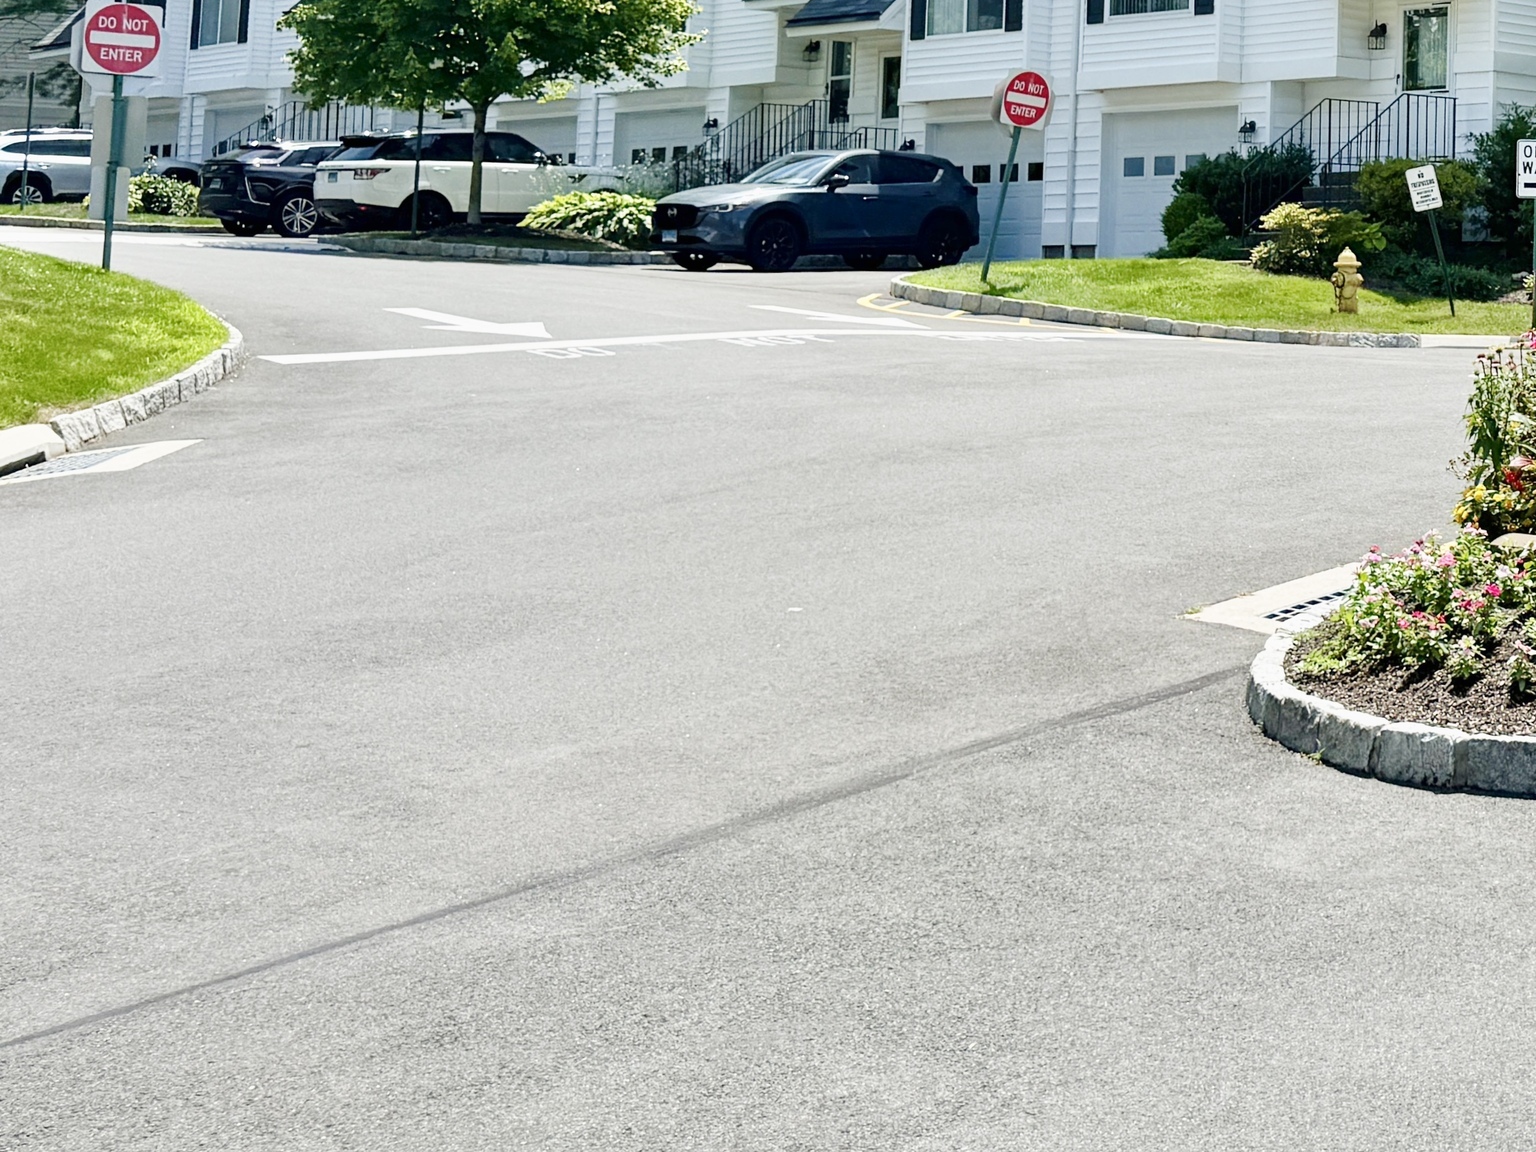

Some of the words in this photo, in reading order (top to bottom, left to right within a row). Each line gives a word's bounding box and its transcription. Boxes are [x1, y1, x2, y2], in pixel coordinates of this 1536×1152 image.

[98, 16, 117, 29] DO
[122, 18, 149, 32] NOT
[100, 47, 142, 63] ENTER
[1014, 80, 1025, 91] DO
[1028, 83, 1045, 95] NOT
[1011, 105, 1036, 118] ENTER
